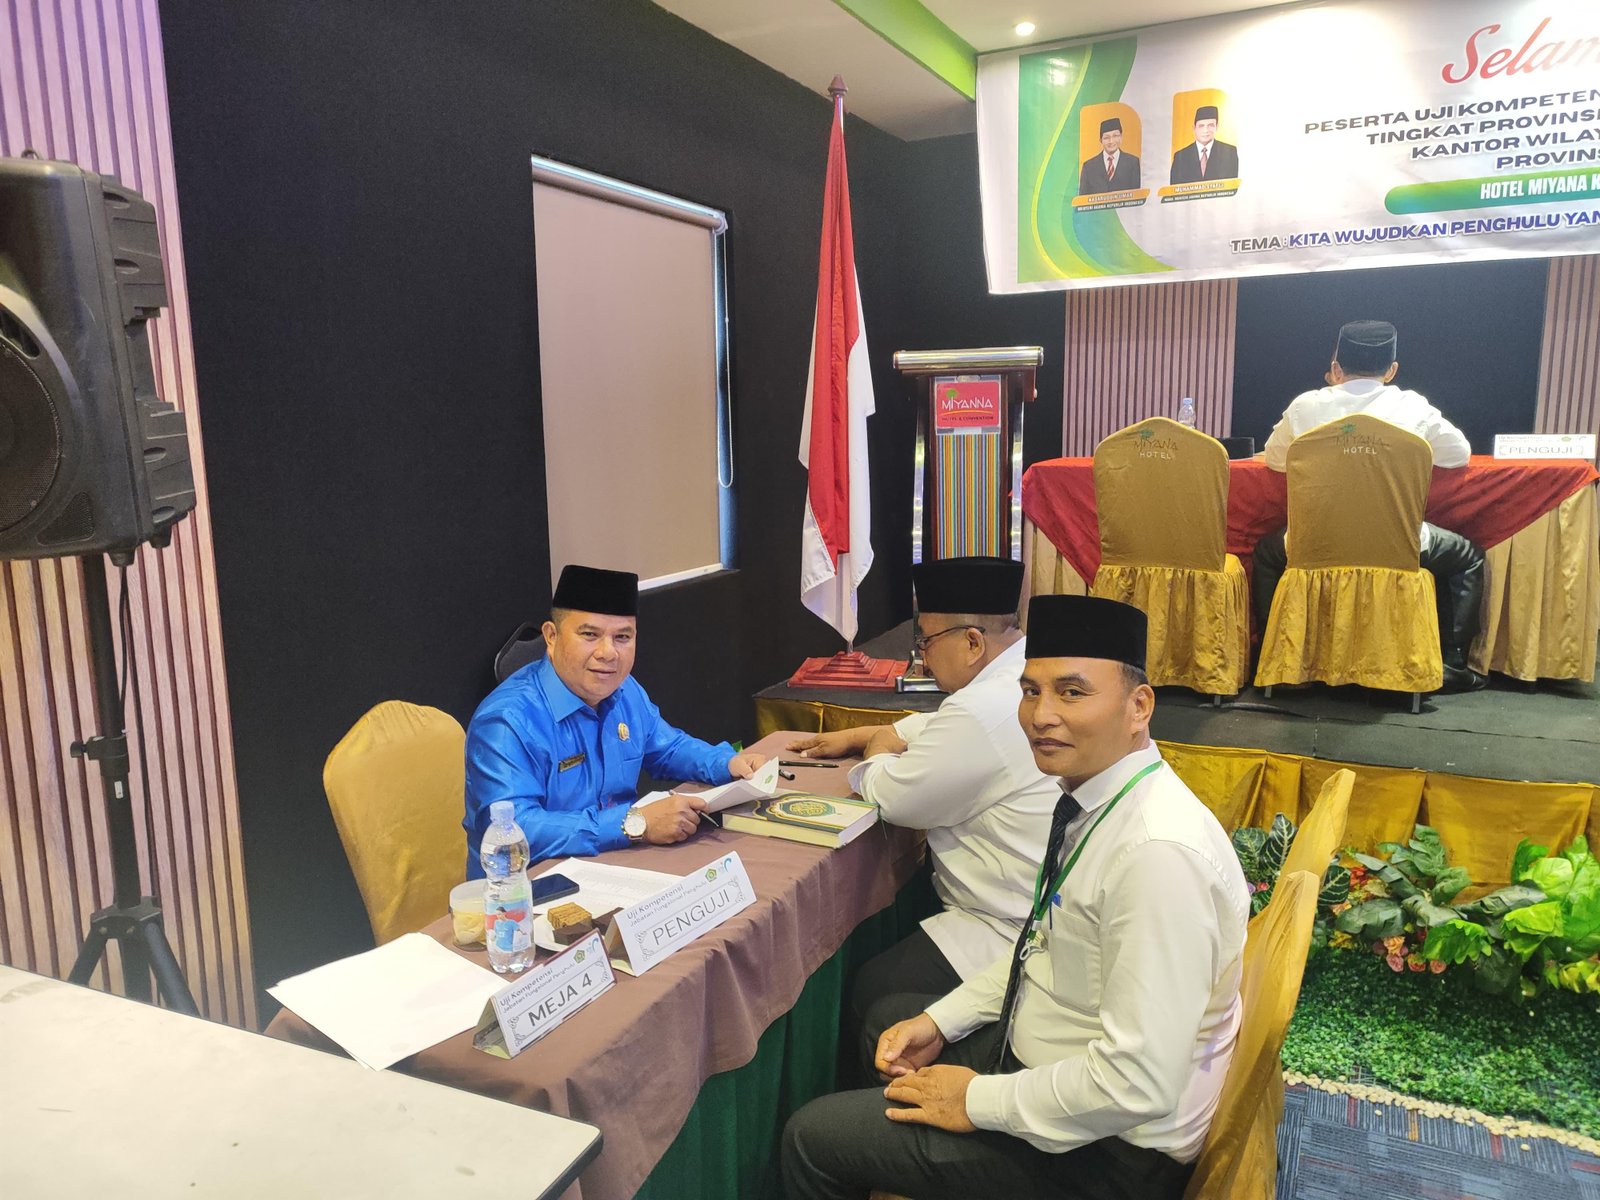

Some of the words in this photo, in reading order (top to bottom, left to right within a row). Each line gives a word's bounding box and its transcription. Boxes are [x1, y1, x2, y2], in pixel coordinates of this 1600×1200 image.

[1305, 111, 1410, 134] PESERTA
[1415, 105, 1453, 121] UJI
[1366, 122, 1474, 145] TINGKAT
[1412, 136, 1520, 159] KANTOR
[1497, 147, 1600, 169] PROVIN
[1480, 180, 1524, 200] HOTEL
[1528, 175, 1588, 196] MIYANA
[1289, 232, 1331, 247] KITA
[1335, 223, 1447, 243] WUJUDKAN
[1450, 213, 1560, 234] PENGHULU
[942, 396, 993, 411] MIYANNA
[1140, 451, 1173, 460] HOTEL
[1343, 446, 1377, 455] HOTEL
[1509, 446, 1573, 454] PENGUJI
[638, 884, 684, 913] Kompetensi
[652, 889, 730, 945] PENGUJI
[511, 968, 554, 999] Kompetensi
[528, 984, 578, 1027] MEJA
[582, 972, 593, 989] 4
